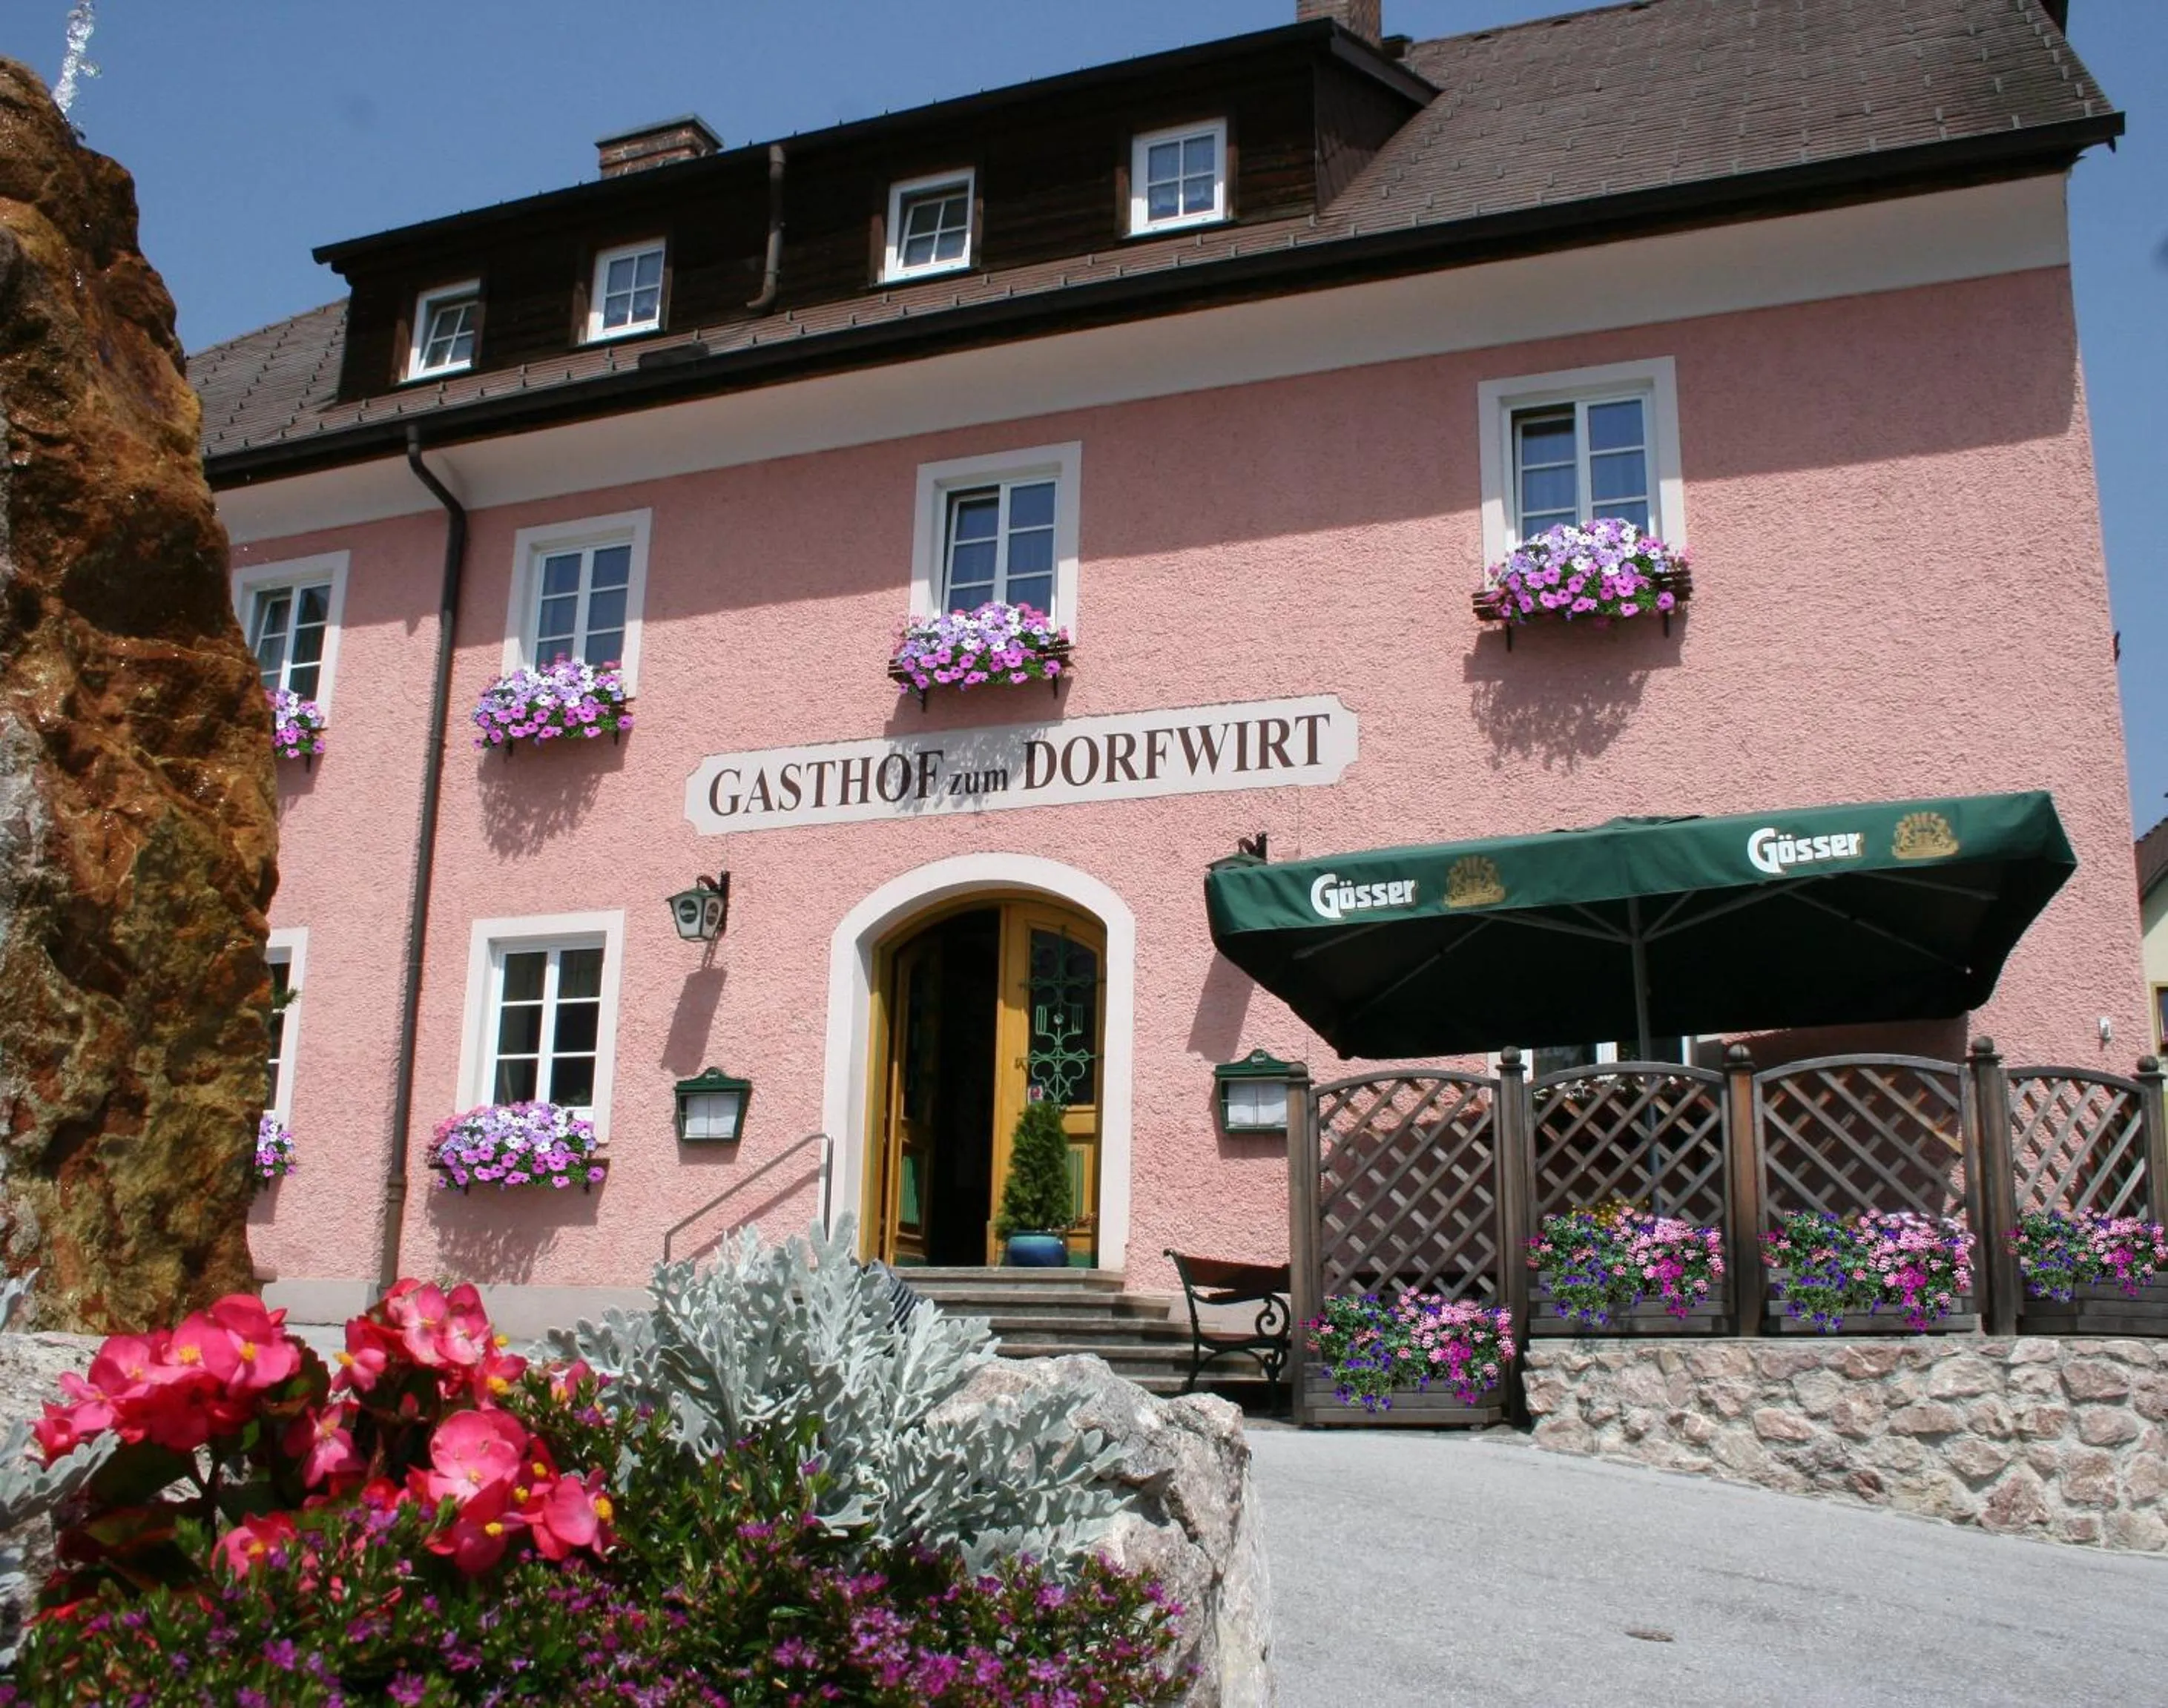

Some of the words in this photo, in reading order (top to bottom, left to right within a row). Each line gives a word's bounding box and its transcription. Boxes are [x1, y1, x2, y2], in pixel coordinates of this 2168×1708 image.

[708, 749, 945, 817] GASTHOF
[948, 768, 1009, 797] zum
[1022, 713, 1331, 791] DORFWIRT
[1747, 827, 1863, 874] Gösser
[1310, 873, 1418, 919] Gösser
